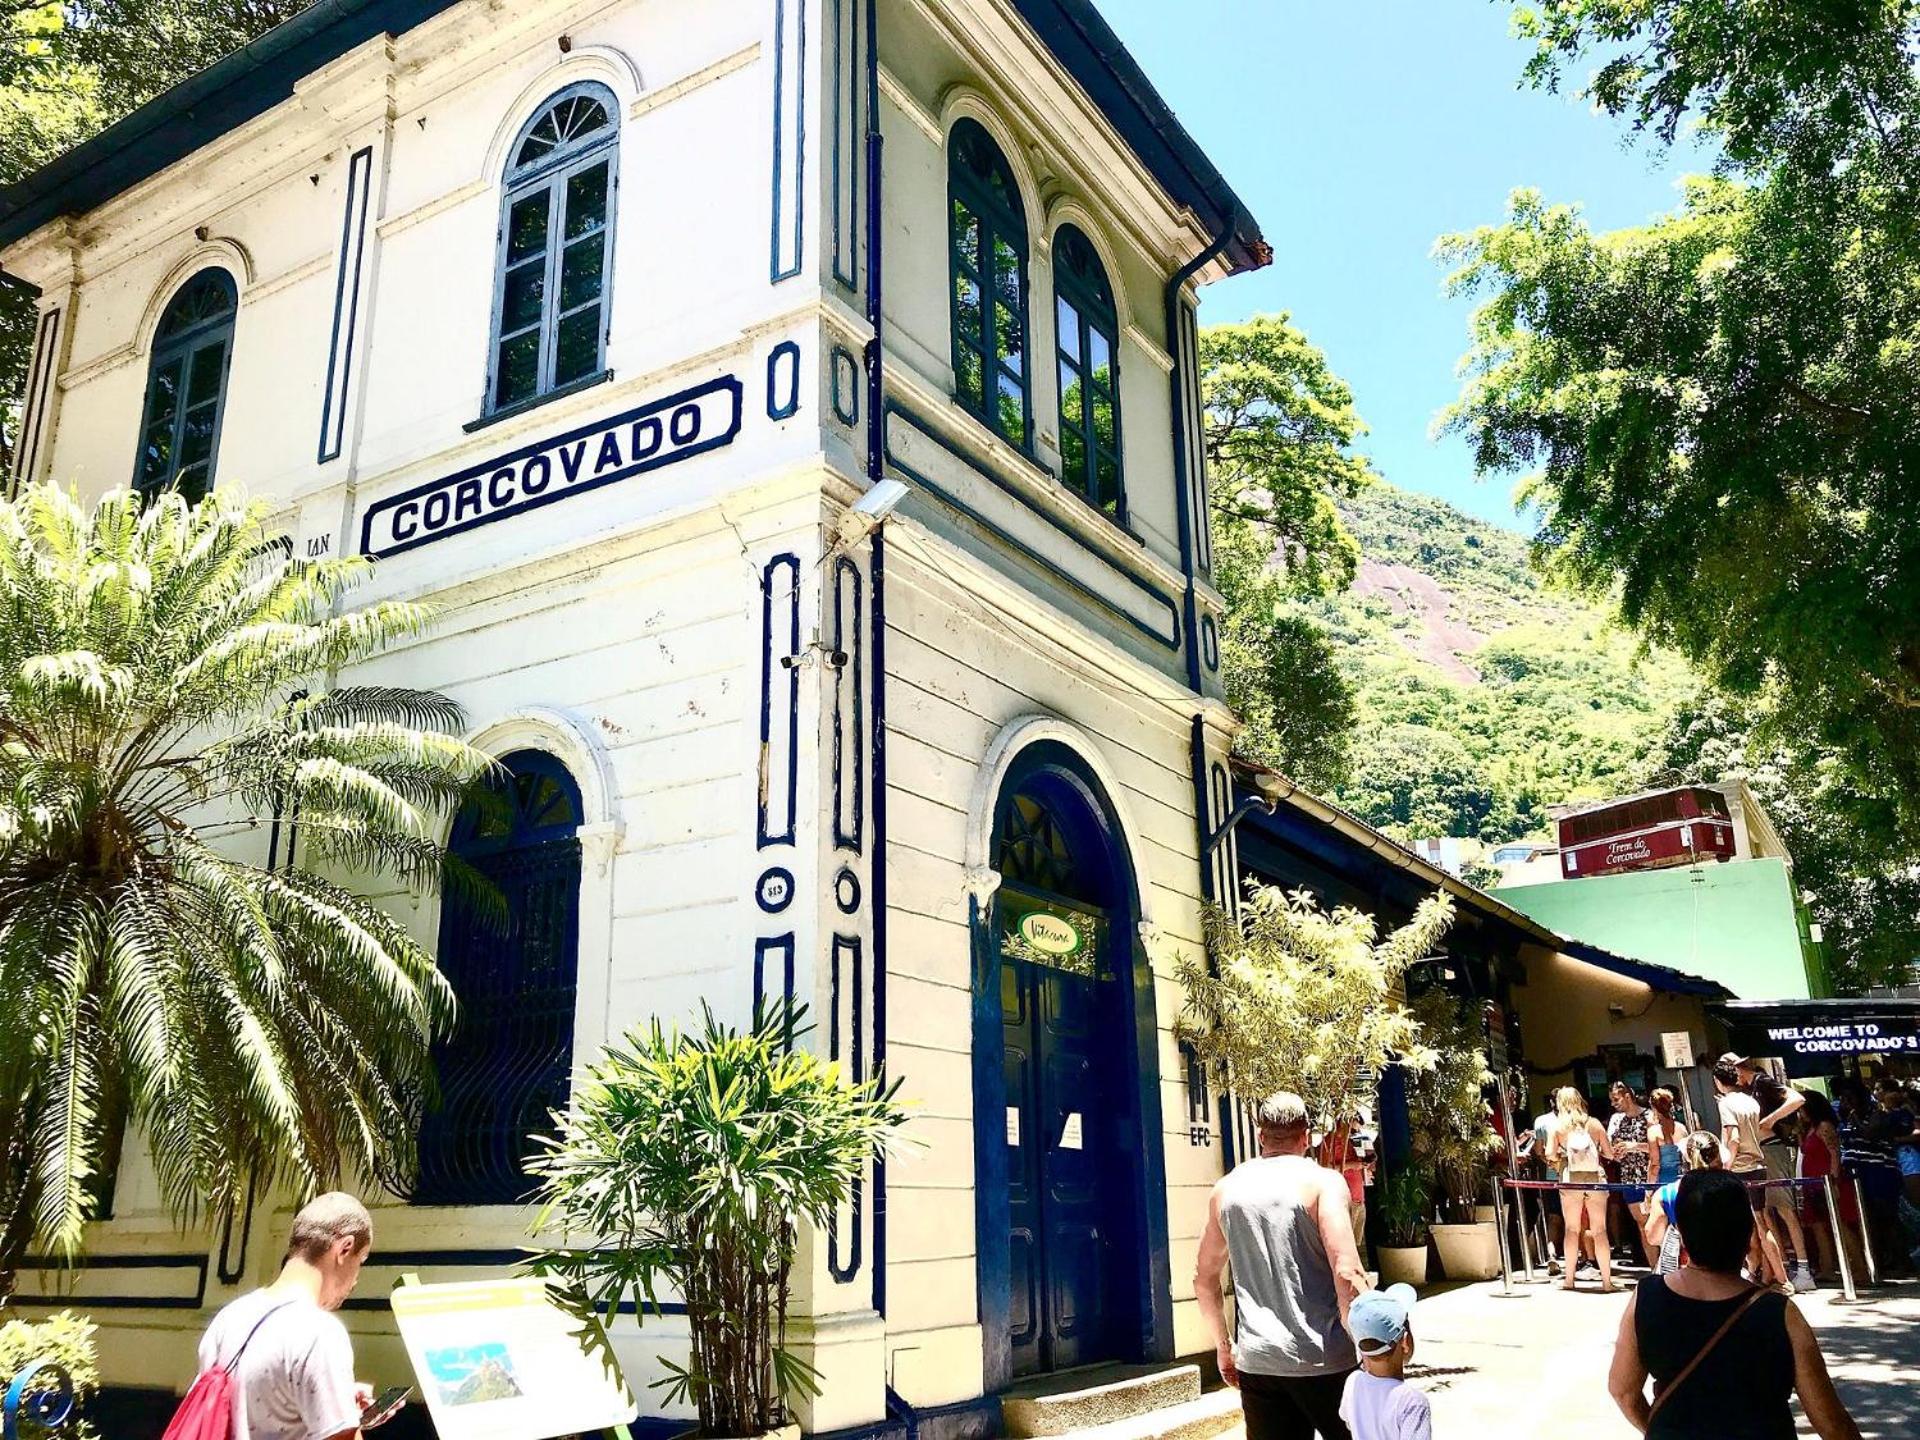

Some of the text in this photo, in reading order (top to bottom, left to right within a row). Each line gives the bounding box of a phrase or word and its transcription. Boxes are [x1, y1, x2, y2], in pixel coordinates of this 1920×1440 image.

[391, 404, 701, 541] CORCOVADO
[1608, 837, 1646, 853] Trem do
[1605, 846, 1651, 865] Corcovado
[1768, 1024, 1880, 1040] WELCOME TO
[1190, 1127, 1211, 1147] EFC
